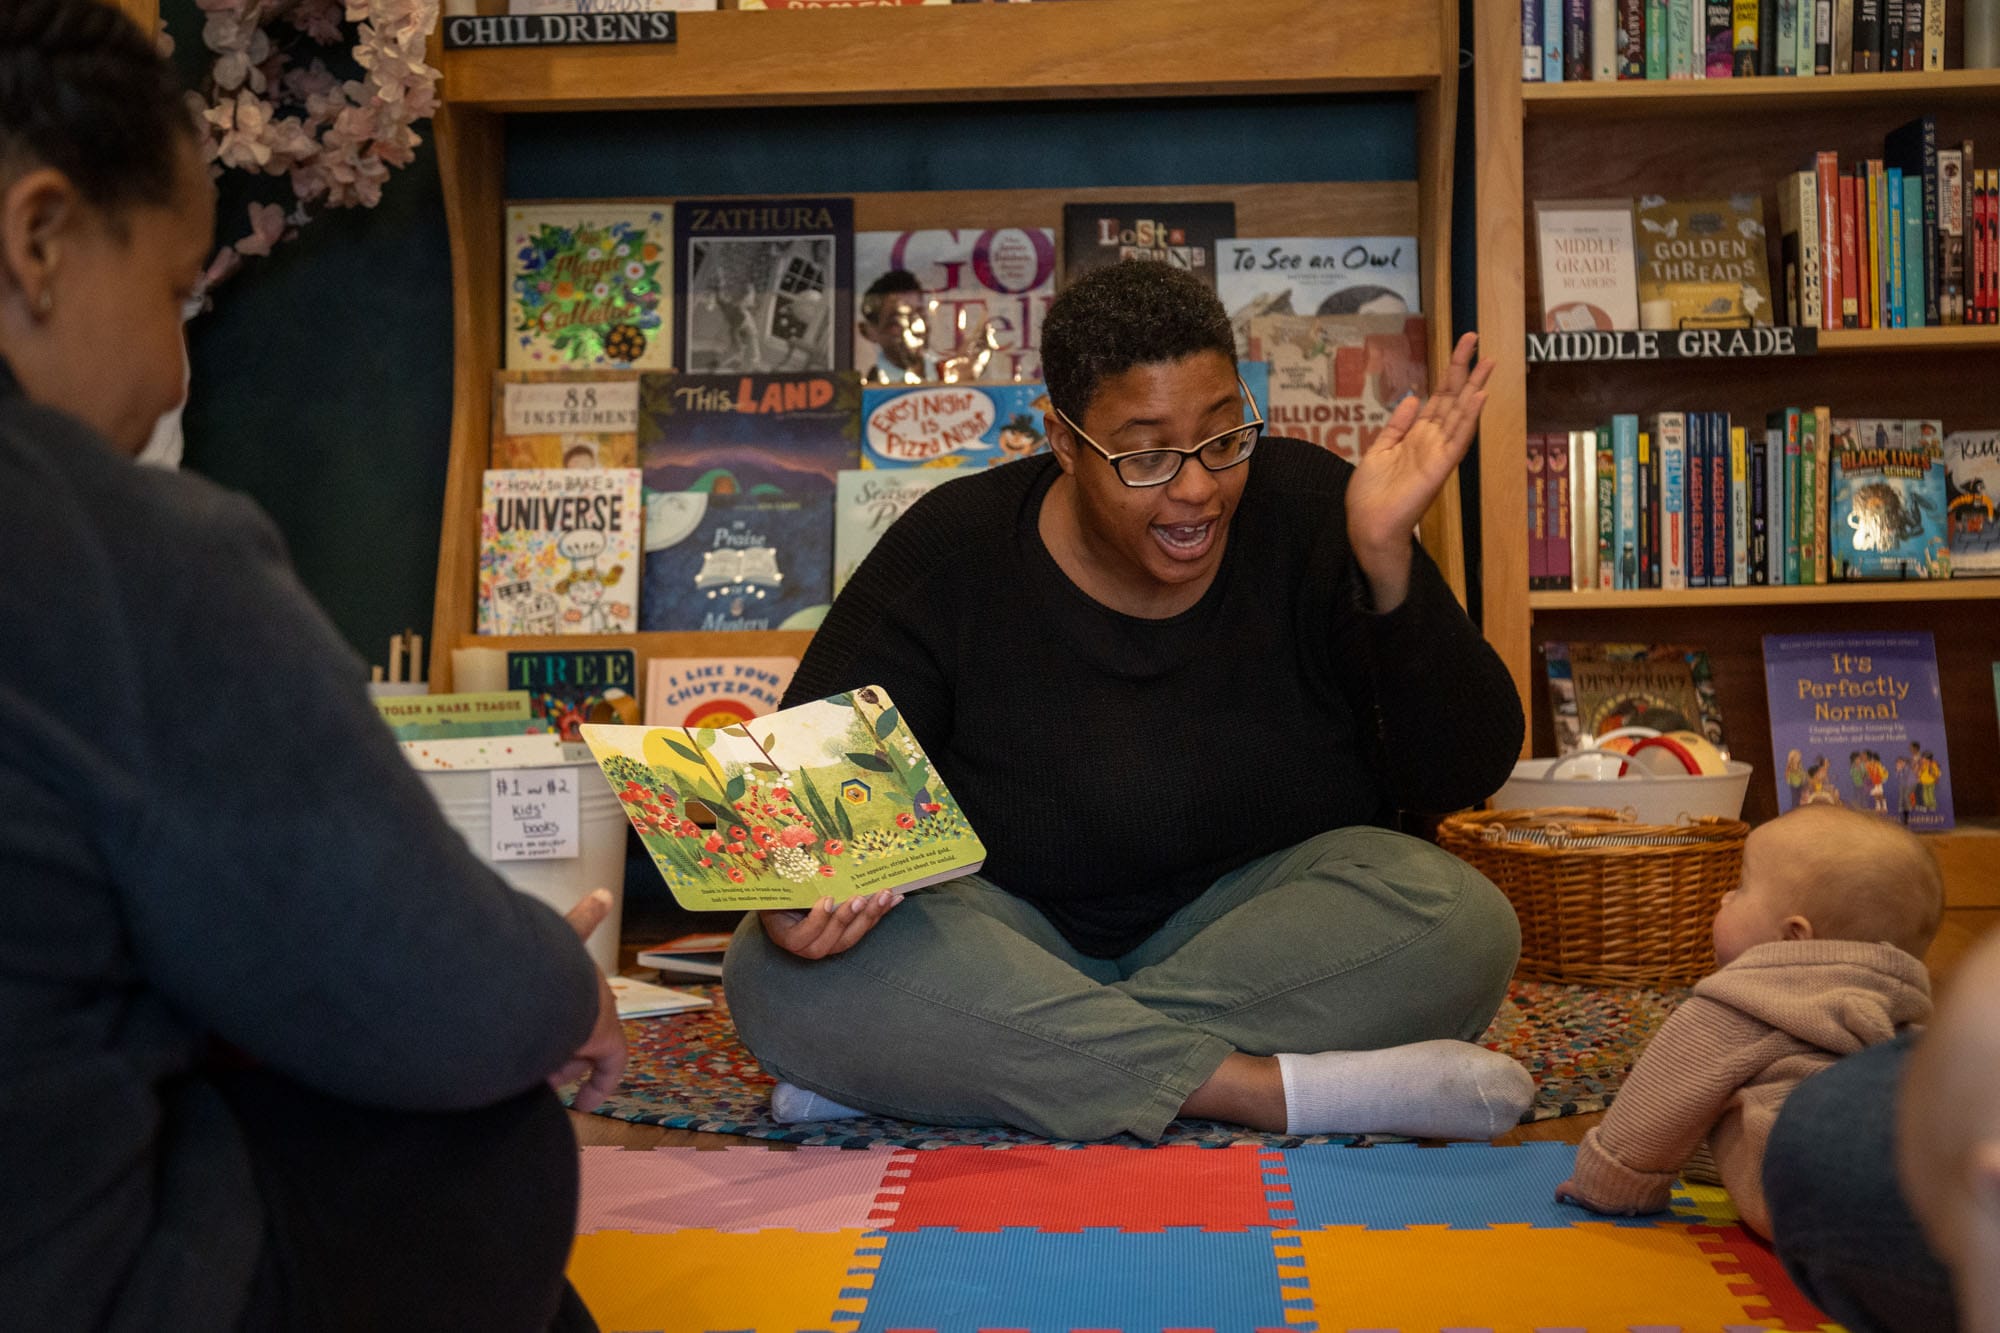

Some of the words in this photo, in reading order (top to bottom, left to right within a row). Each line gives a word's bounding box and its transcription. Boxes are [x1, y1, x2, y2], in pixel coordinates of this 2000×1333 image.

[450, 13, 670, 46] CHILDREN'S
[690, 207, 835, 231] ZATHURA
[1554, 236, 1621, 254] MIDDLE
[1655, 239, 1748, 260] GOLDEN
[891, 229, 1056, 295] GO
[1233, 247, 1256, 271] To
[1261, 246, 1302, 271] See
[1309, 254, 1335, 270] an
[1342, 245, 1402, 271] Owl
[1555, 256, 1616, 274] GRADE
[1651, 258, 1756, 283] THREADS
[1527, 331, 1660, 362] MIDDLE
[1677, 327, 1796, 358] GRADE
[564, 387, 598, 409] 88
[735, 377, 834, 414] LAND
[1841, 448, 1888, 471] BLACK
[1891, 449, 1932, 471] LIVES
[498, 494, 622, 534] UNIVERSE
[513, 655, 630, 686] TREE
[1831, 652, 1872, 674] It's
[685, 665, 724, 681] LIKE
[735, 665, 780, 687] YOUR
[1798, 674, 1910, 700] Perfectly
[666, 681, 778, 706] CHUTZPAH
[437, 702, 472, 714] MARK
[476, 699, 522, 713] TEAGUE
[1815, 699, 1898, 721] Normal
[522, 821, 560, 834] books
[861, 877, 881, 887] wonder
[887, 869, 906, 878] nature
[913, 862, 930, 871] about
[937, 854, 958, 864] unfold.
[866, 864, 890, 877] appears,
[889, 857, 910, 868] striped
[910, 853, 925, 863] black
[937, 846, 953, 856] gold.
